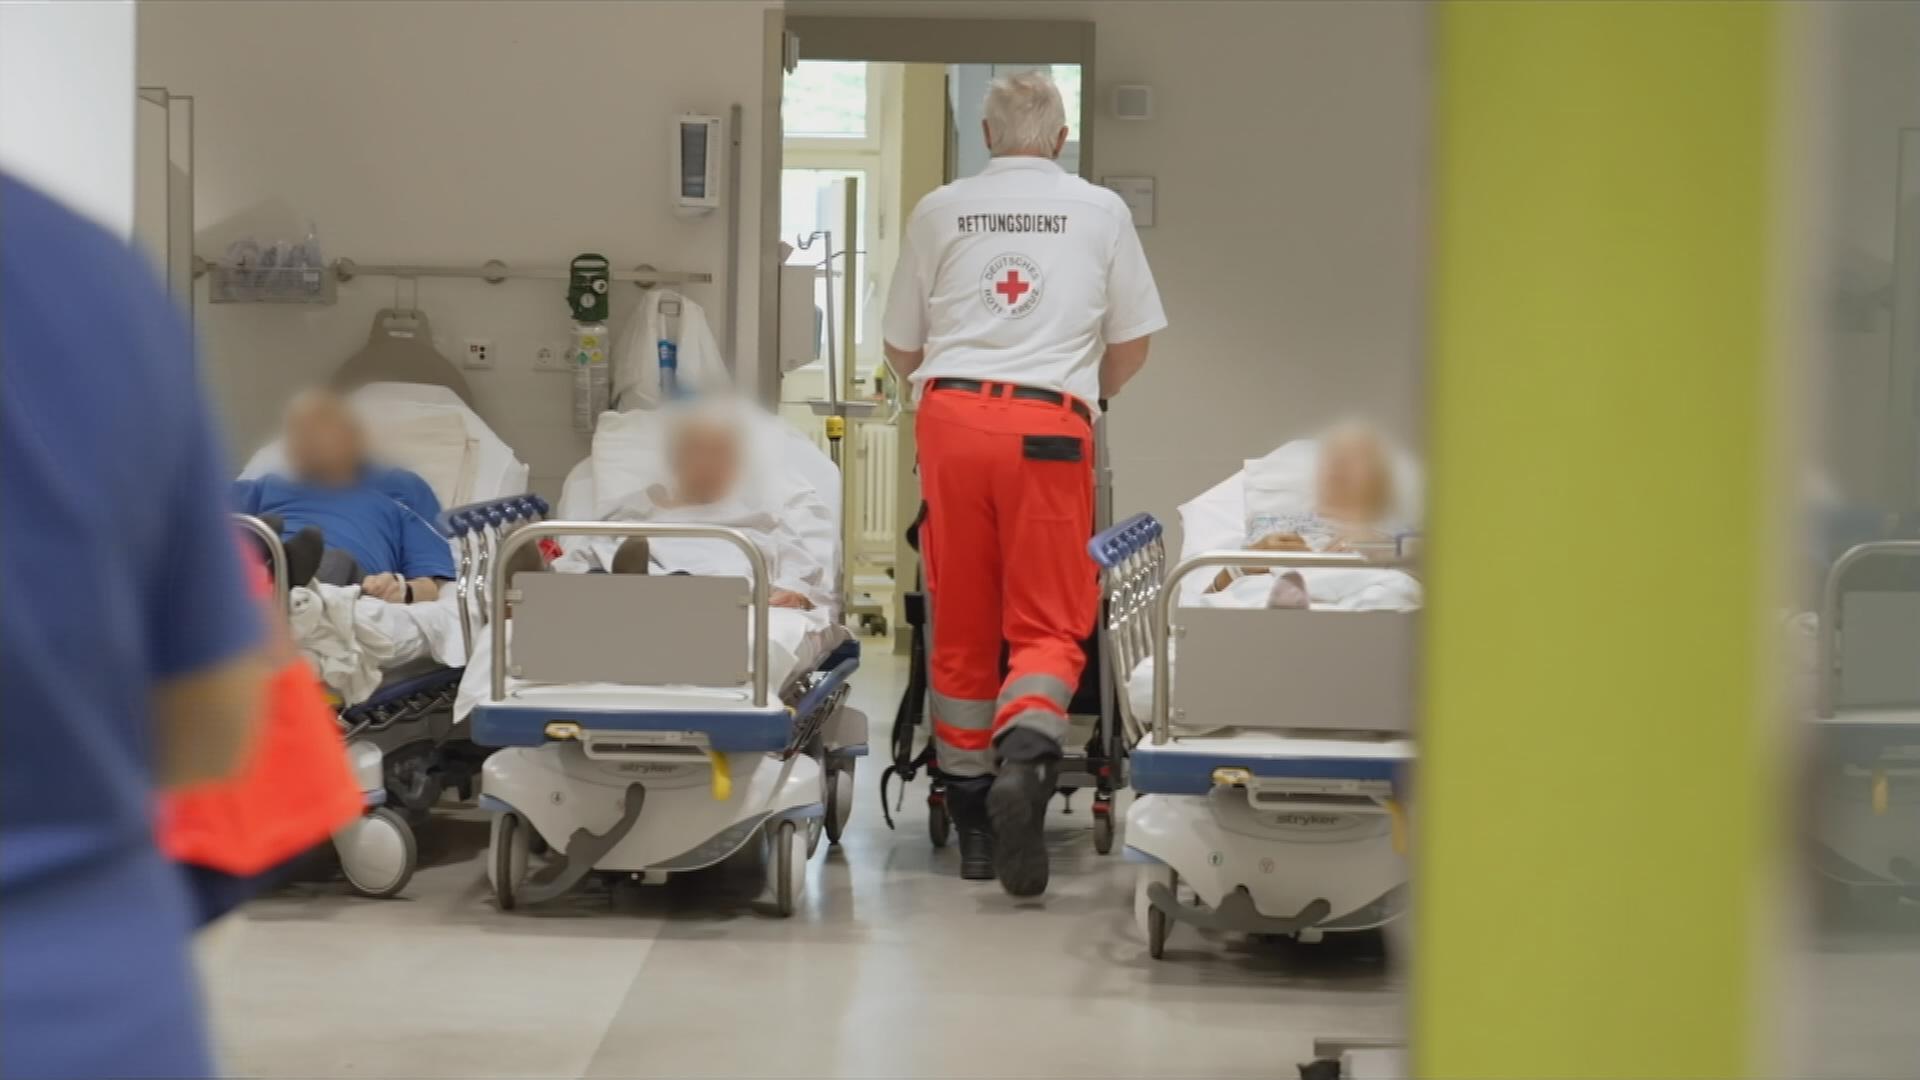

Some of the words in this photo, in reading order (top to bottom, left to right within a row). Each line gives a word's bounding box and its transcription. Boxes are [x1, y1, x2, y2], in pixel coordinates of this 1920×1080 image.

[958, 214, 1068, 234] RETTUNGSDIENST
[985, 256, 1039, 281] DEUTSCHES
[1276, 813, 1340, 826] stryker
